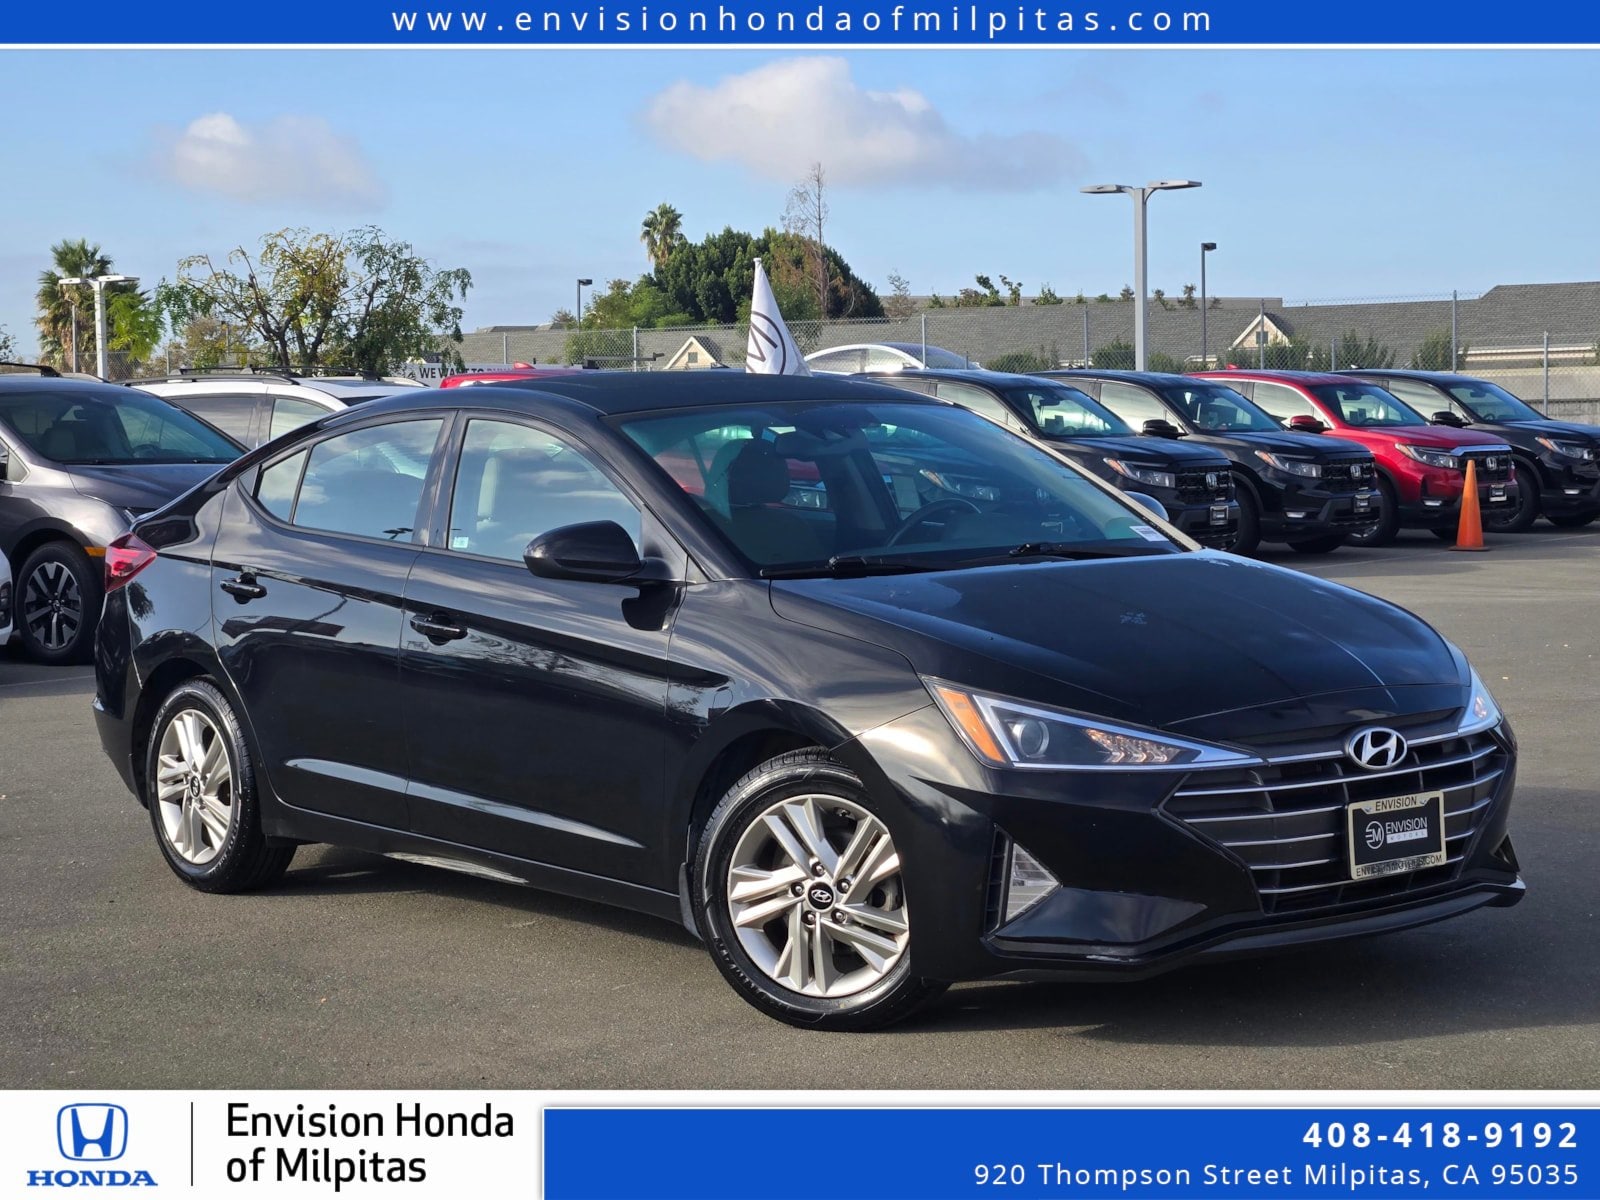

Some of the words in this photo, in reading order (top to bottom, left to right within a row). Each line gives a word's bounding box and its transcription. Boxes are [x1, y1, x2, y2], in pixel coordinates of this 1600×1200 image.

[420, 367, 436, 378] WE
[438, 367, 470, 378] WAT
[1375, 796, 1417, 811] ENVISION
[1385, 817, 1428, 834] ENVISION
